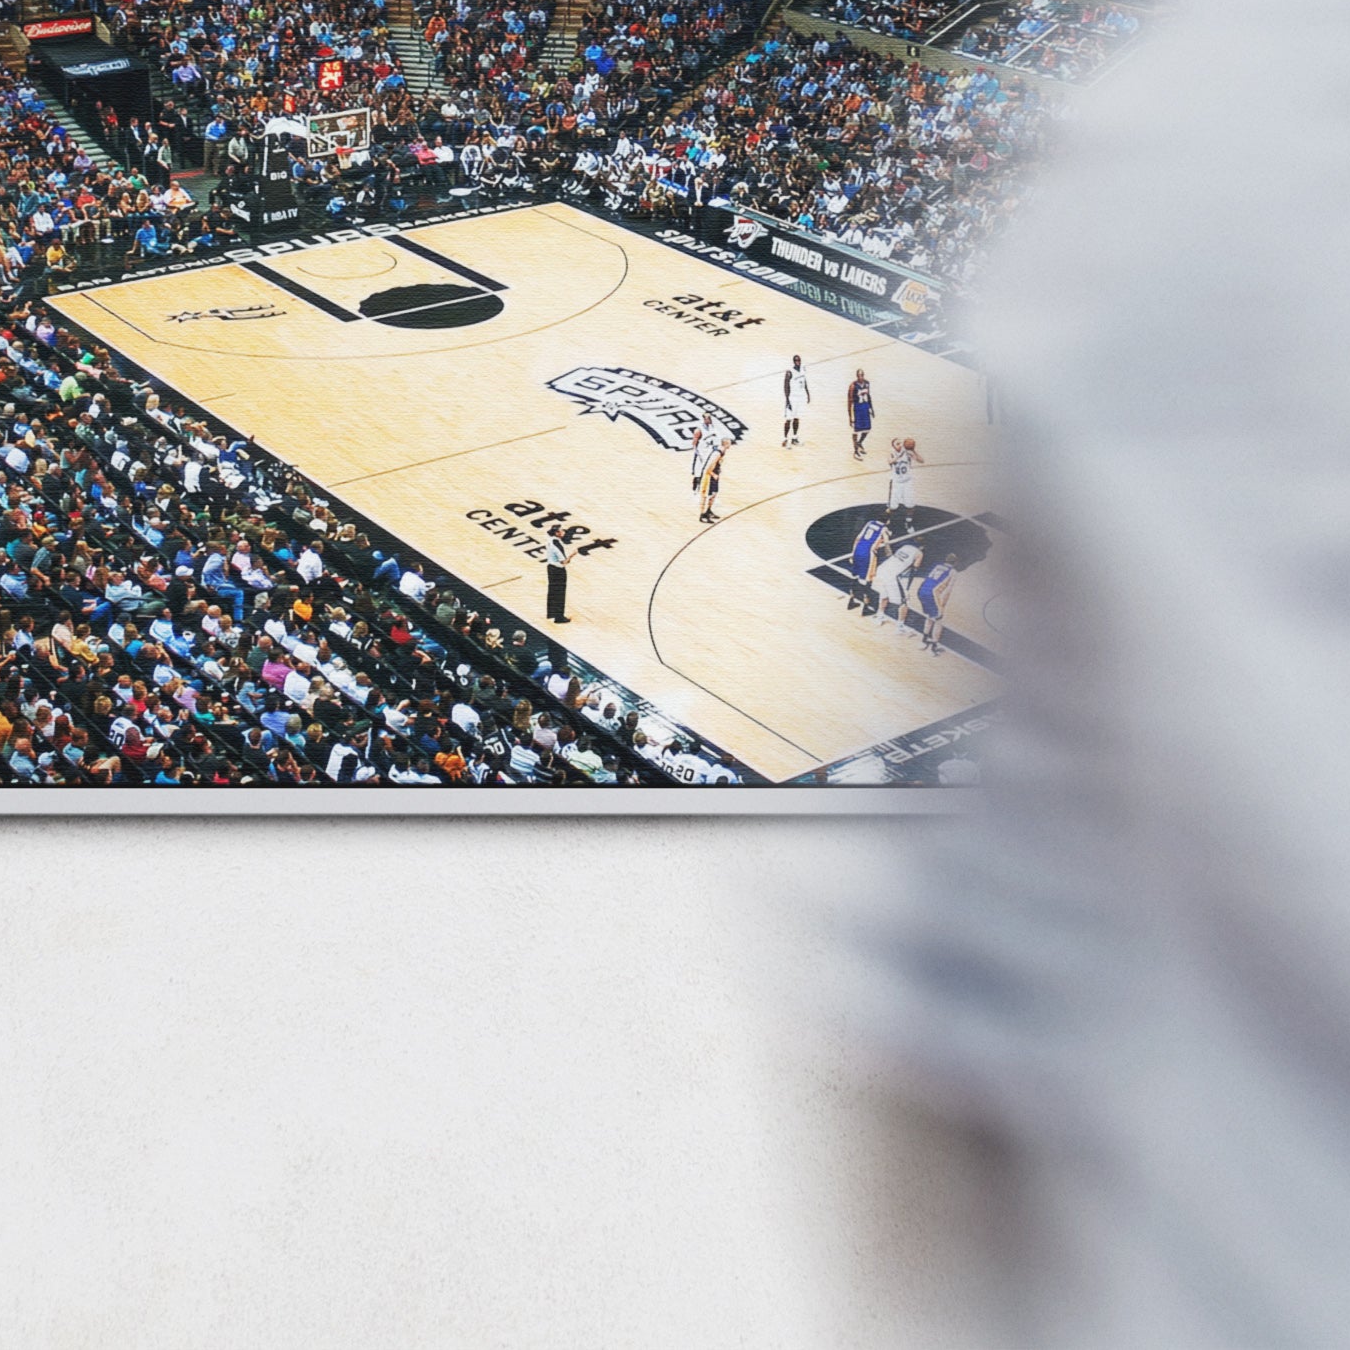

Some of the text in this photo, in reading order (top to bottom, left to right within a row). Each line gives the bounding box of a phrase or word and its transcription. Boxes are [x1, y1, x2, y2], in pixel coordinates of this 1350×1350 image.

[25, 21, 92, 38] Budweiser
[57, 201, 533, 292] SAN ANTONIO SPURS BASKETBALL
[655, 229, 799, 286] spurs.com
[771, 236, 823, 272] THUNDER
[840, 263, 887, 296] LAKERS
[643, 299, 731, 338] CENTER
[672, 293, 766, 330] at&t
[466, 509, 550, 564] CENTE
[675, 763, 695, 782] 20
